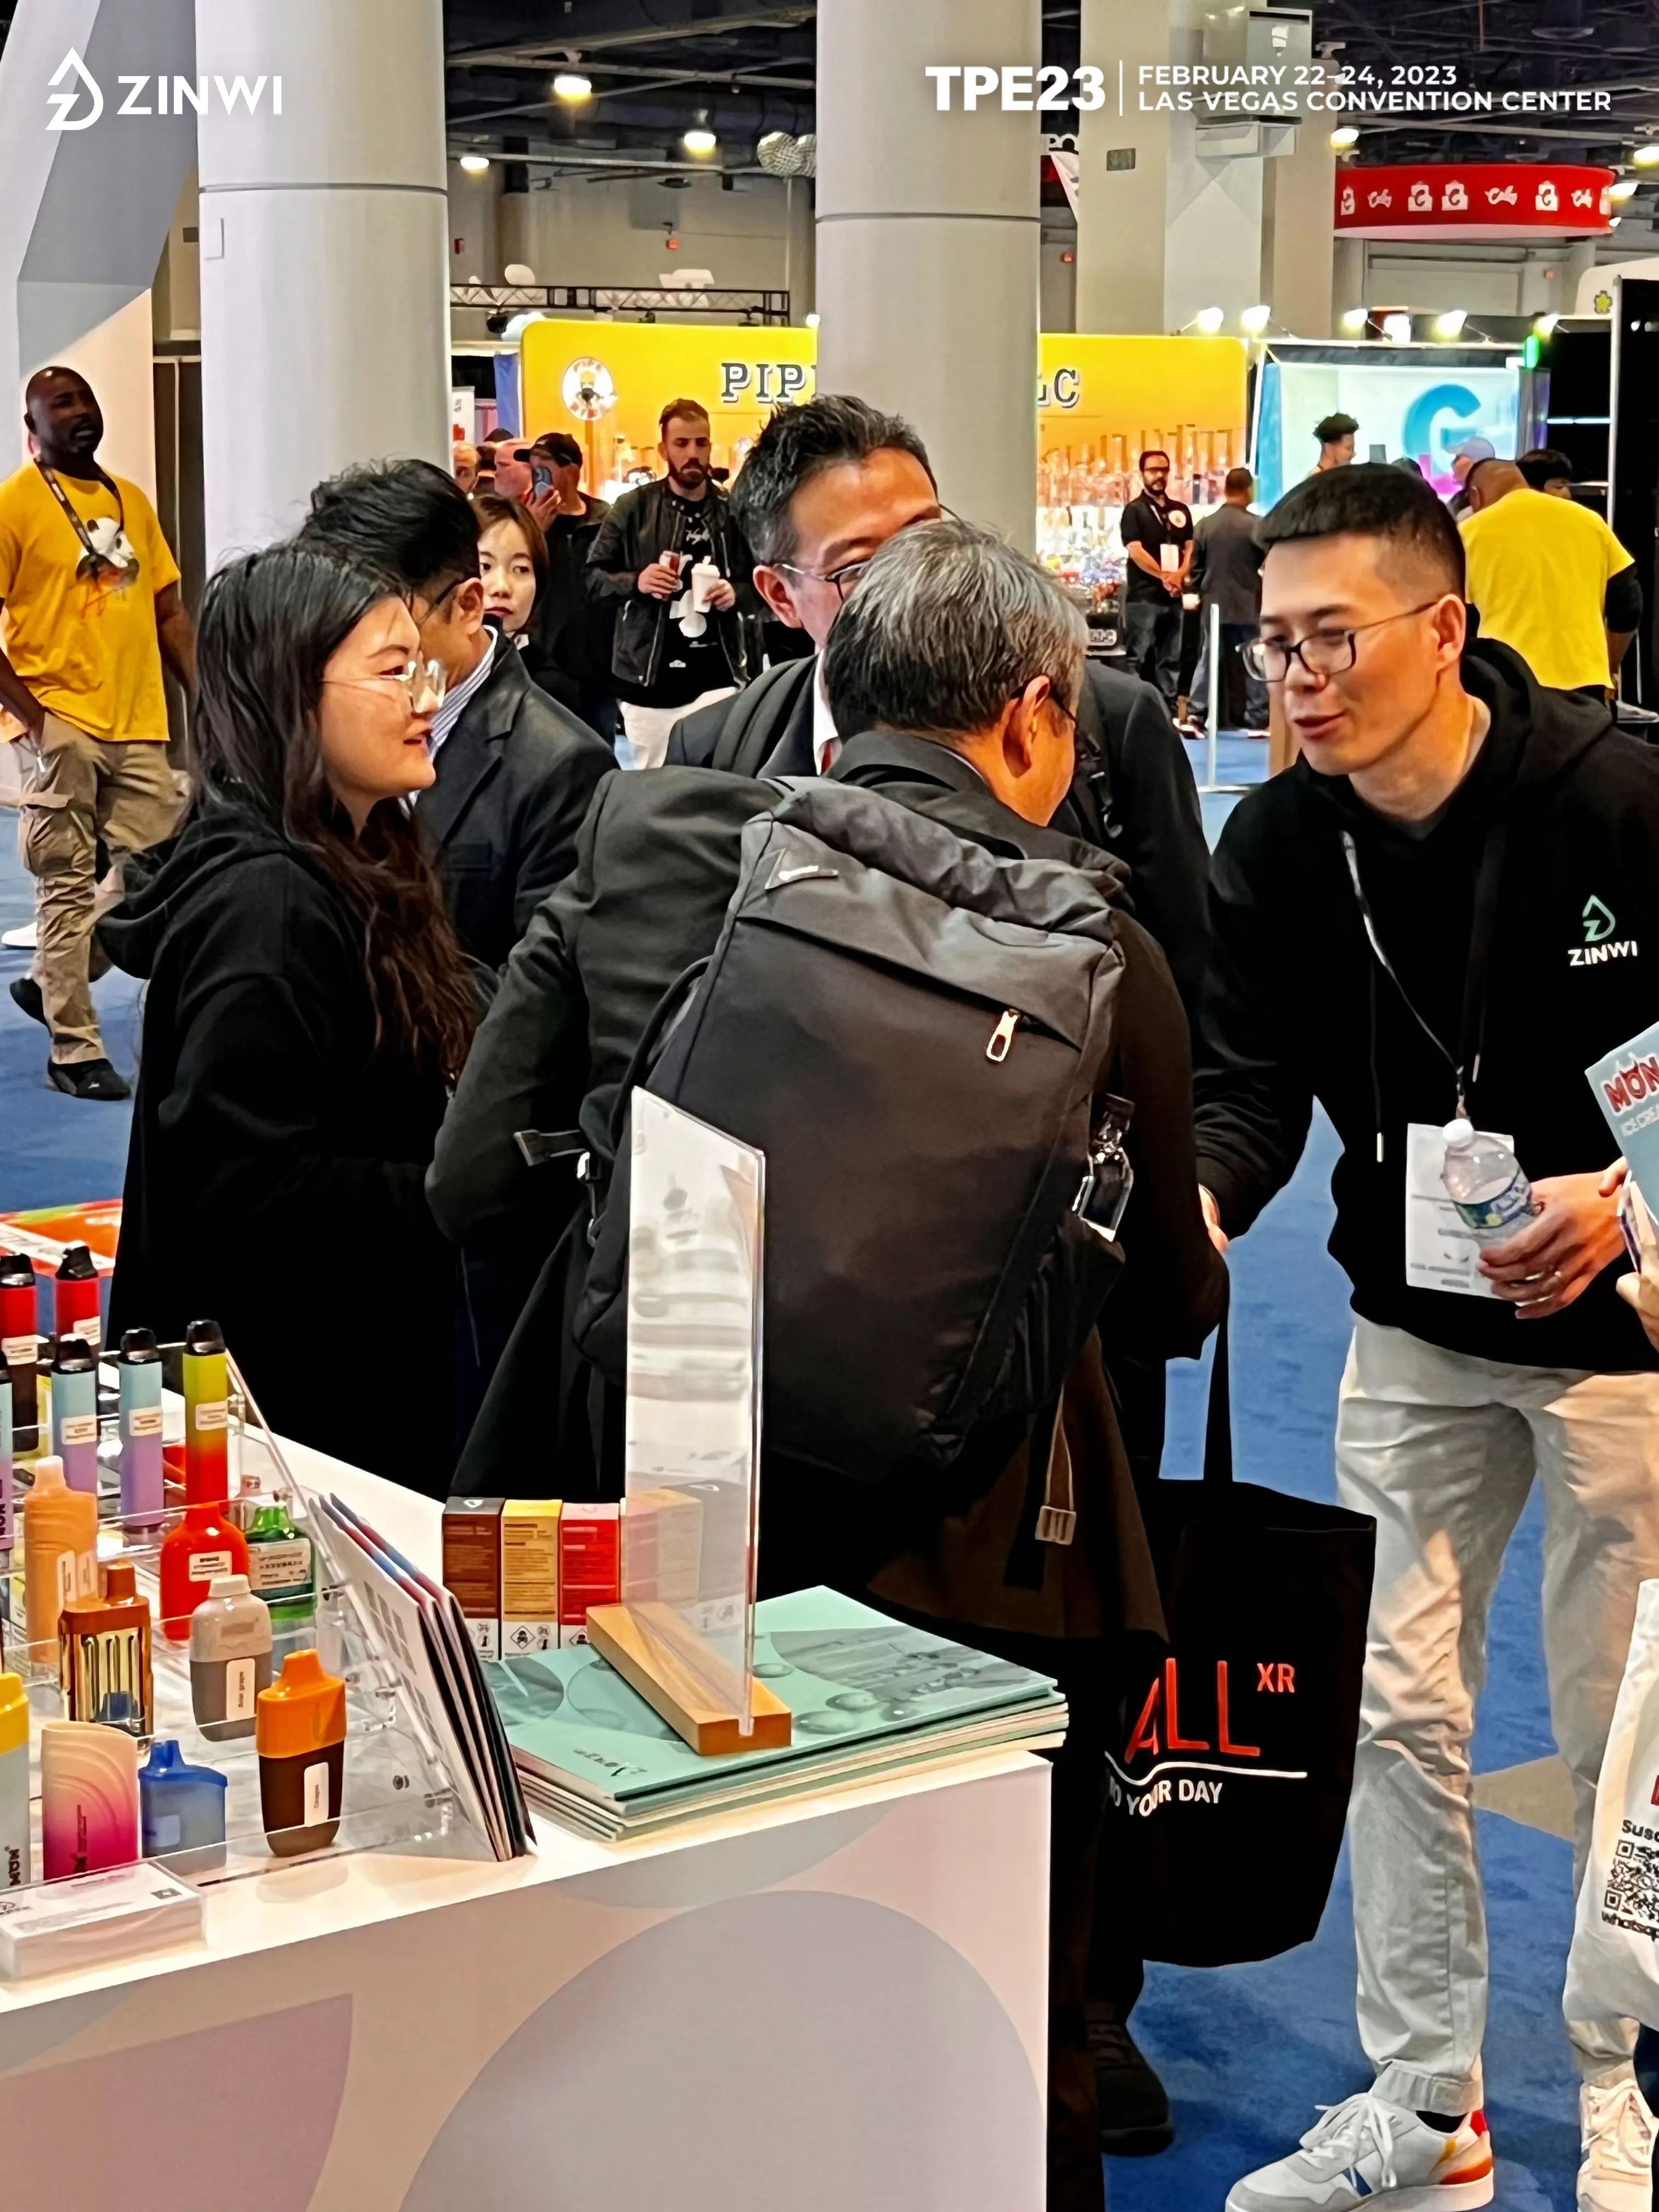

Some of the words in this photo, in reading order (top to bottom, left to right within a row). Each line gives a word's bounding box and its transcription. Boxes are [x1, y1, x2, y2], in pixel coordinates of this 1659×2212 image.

[721, 363, 816, 403] PIP
[1567, 940, 1638, 967] ZINWI
[1256, 1663, 1295, 1694] XR
[1126, 1780, 1172, 1817] YOUR
[1178, 1779, 1223, 1804] DAY
